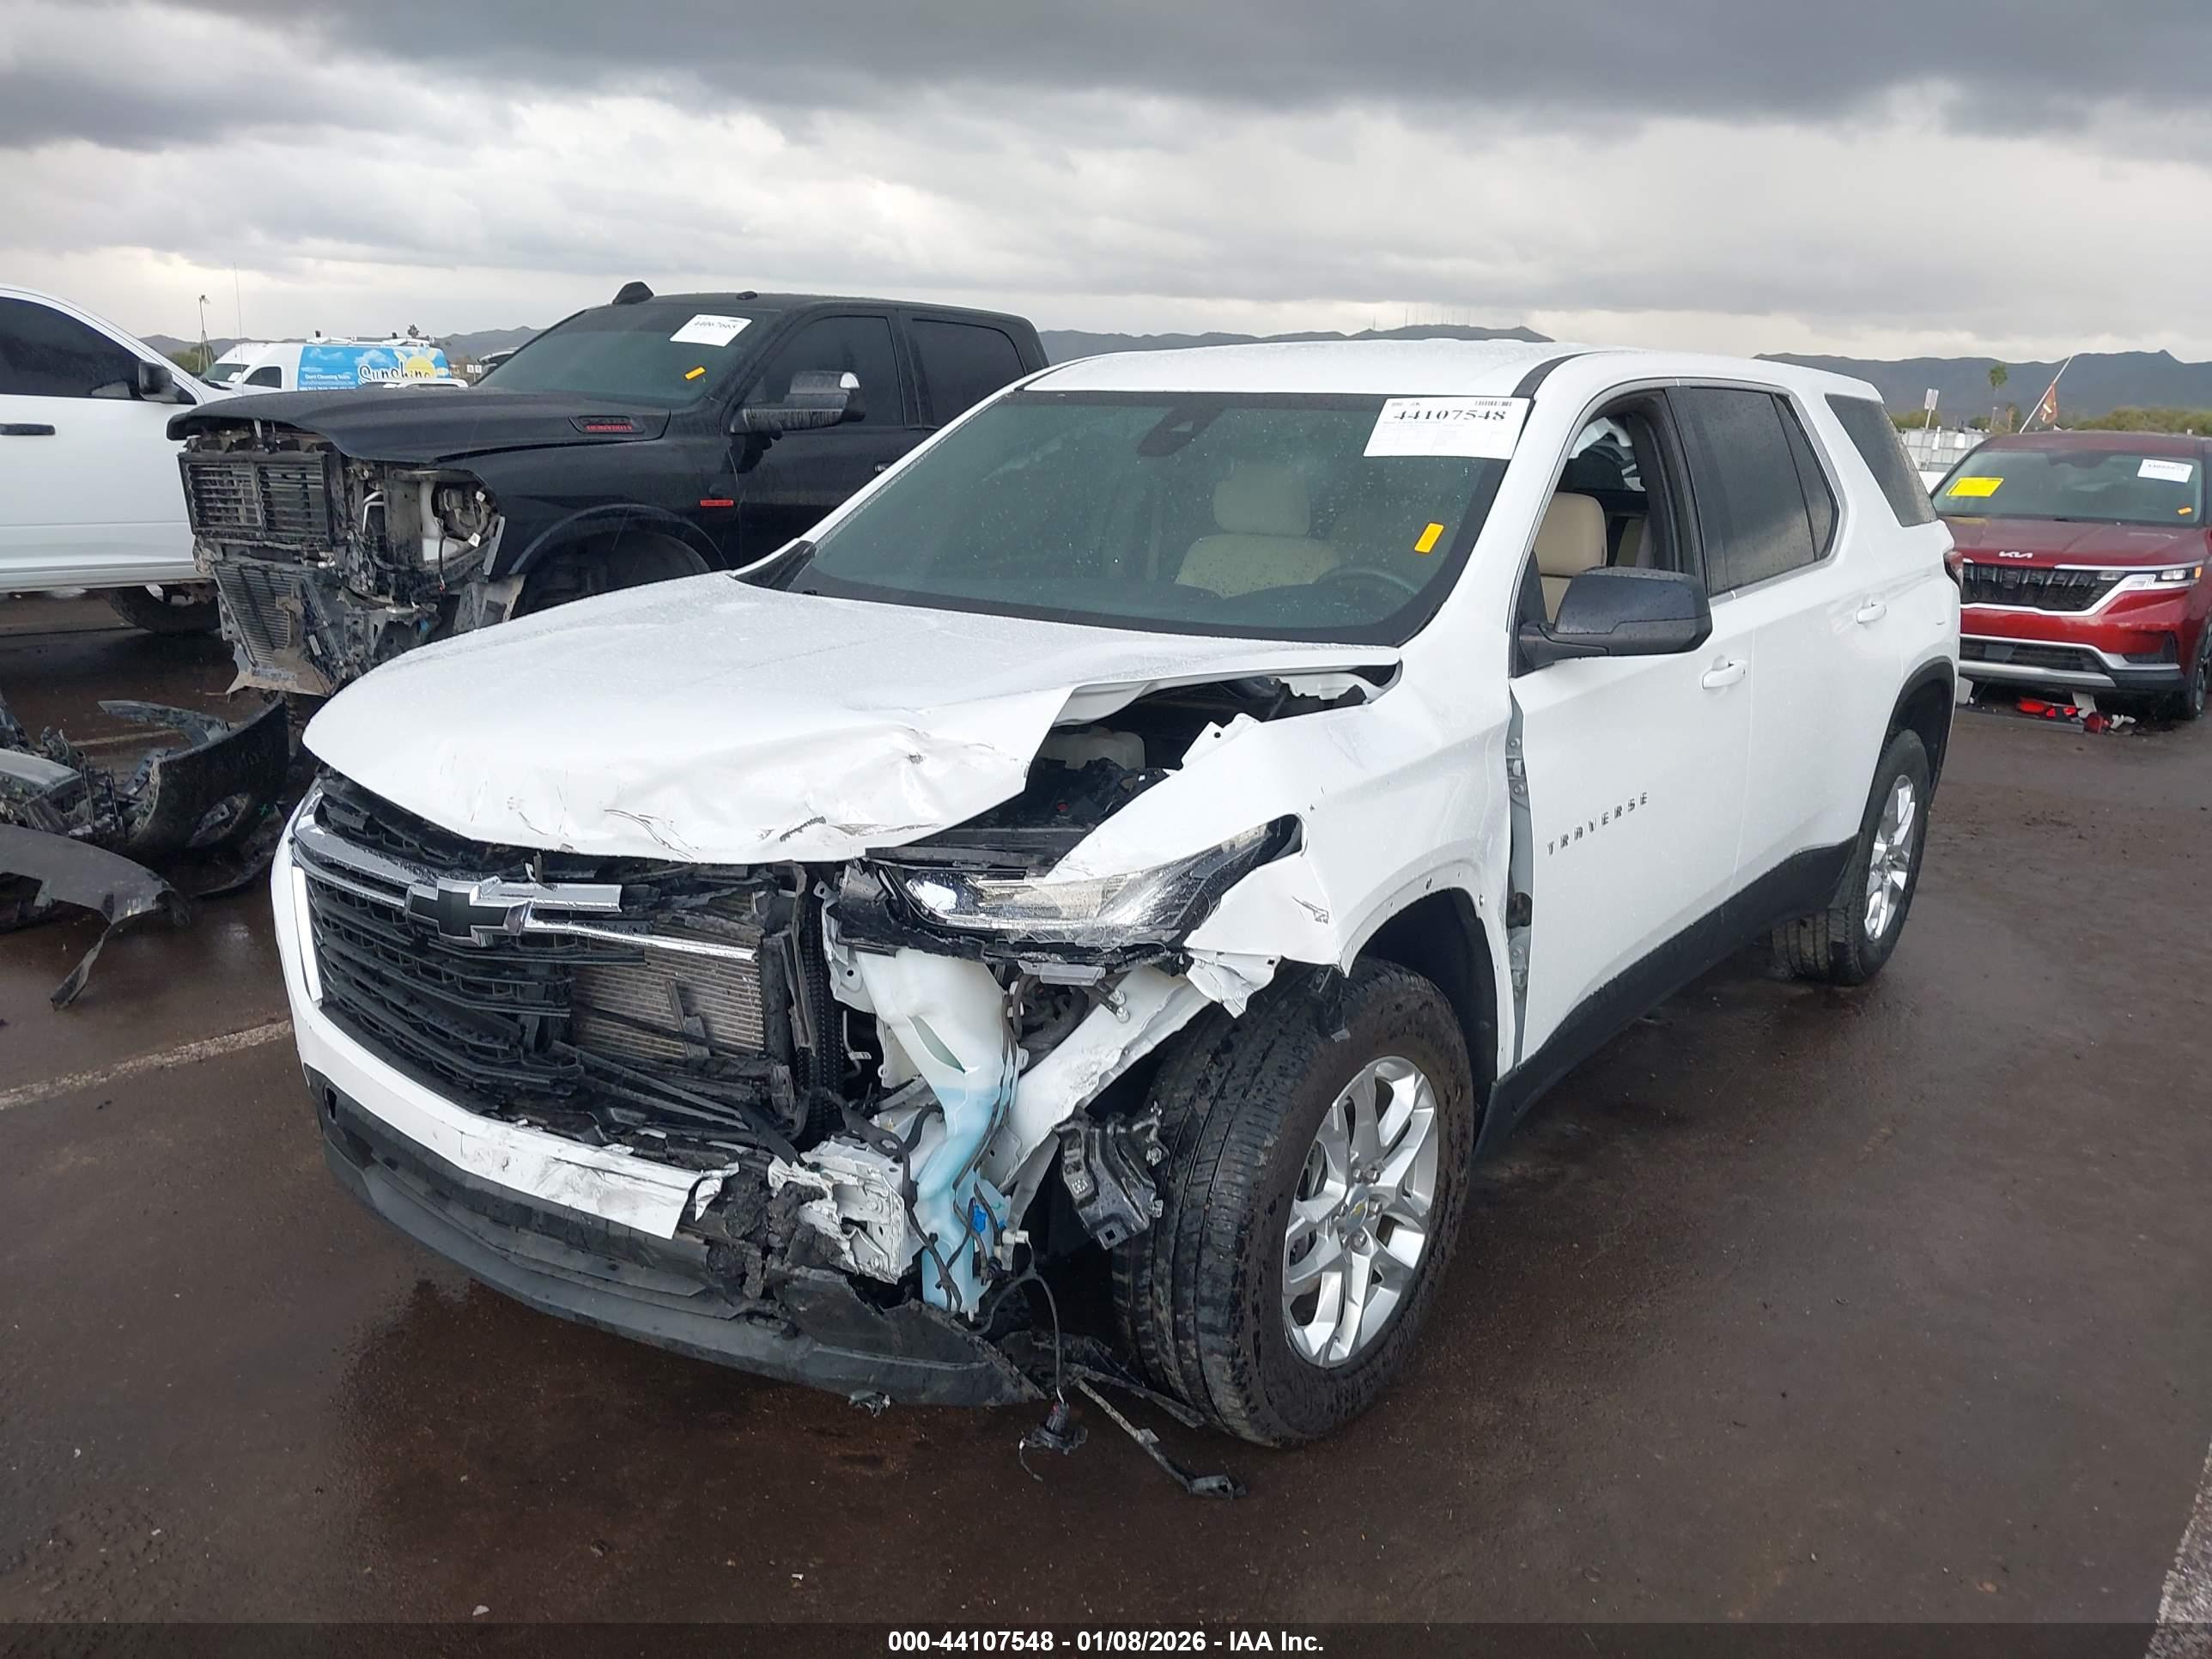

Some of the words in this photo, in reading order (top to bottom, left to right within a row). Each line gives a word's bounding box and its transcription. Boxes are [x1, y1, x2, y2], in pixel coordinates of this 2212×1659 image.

[1394, 410, 1506, 420] 44107548
[1998, 550, 2033, 559] KIA
[1547, 792, 1648, 855] TRAVERSE
